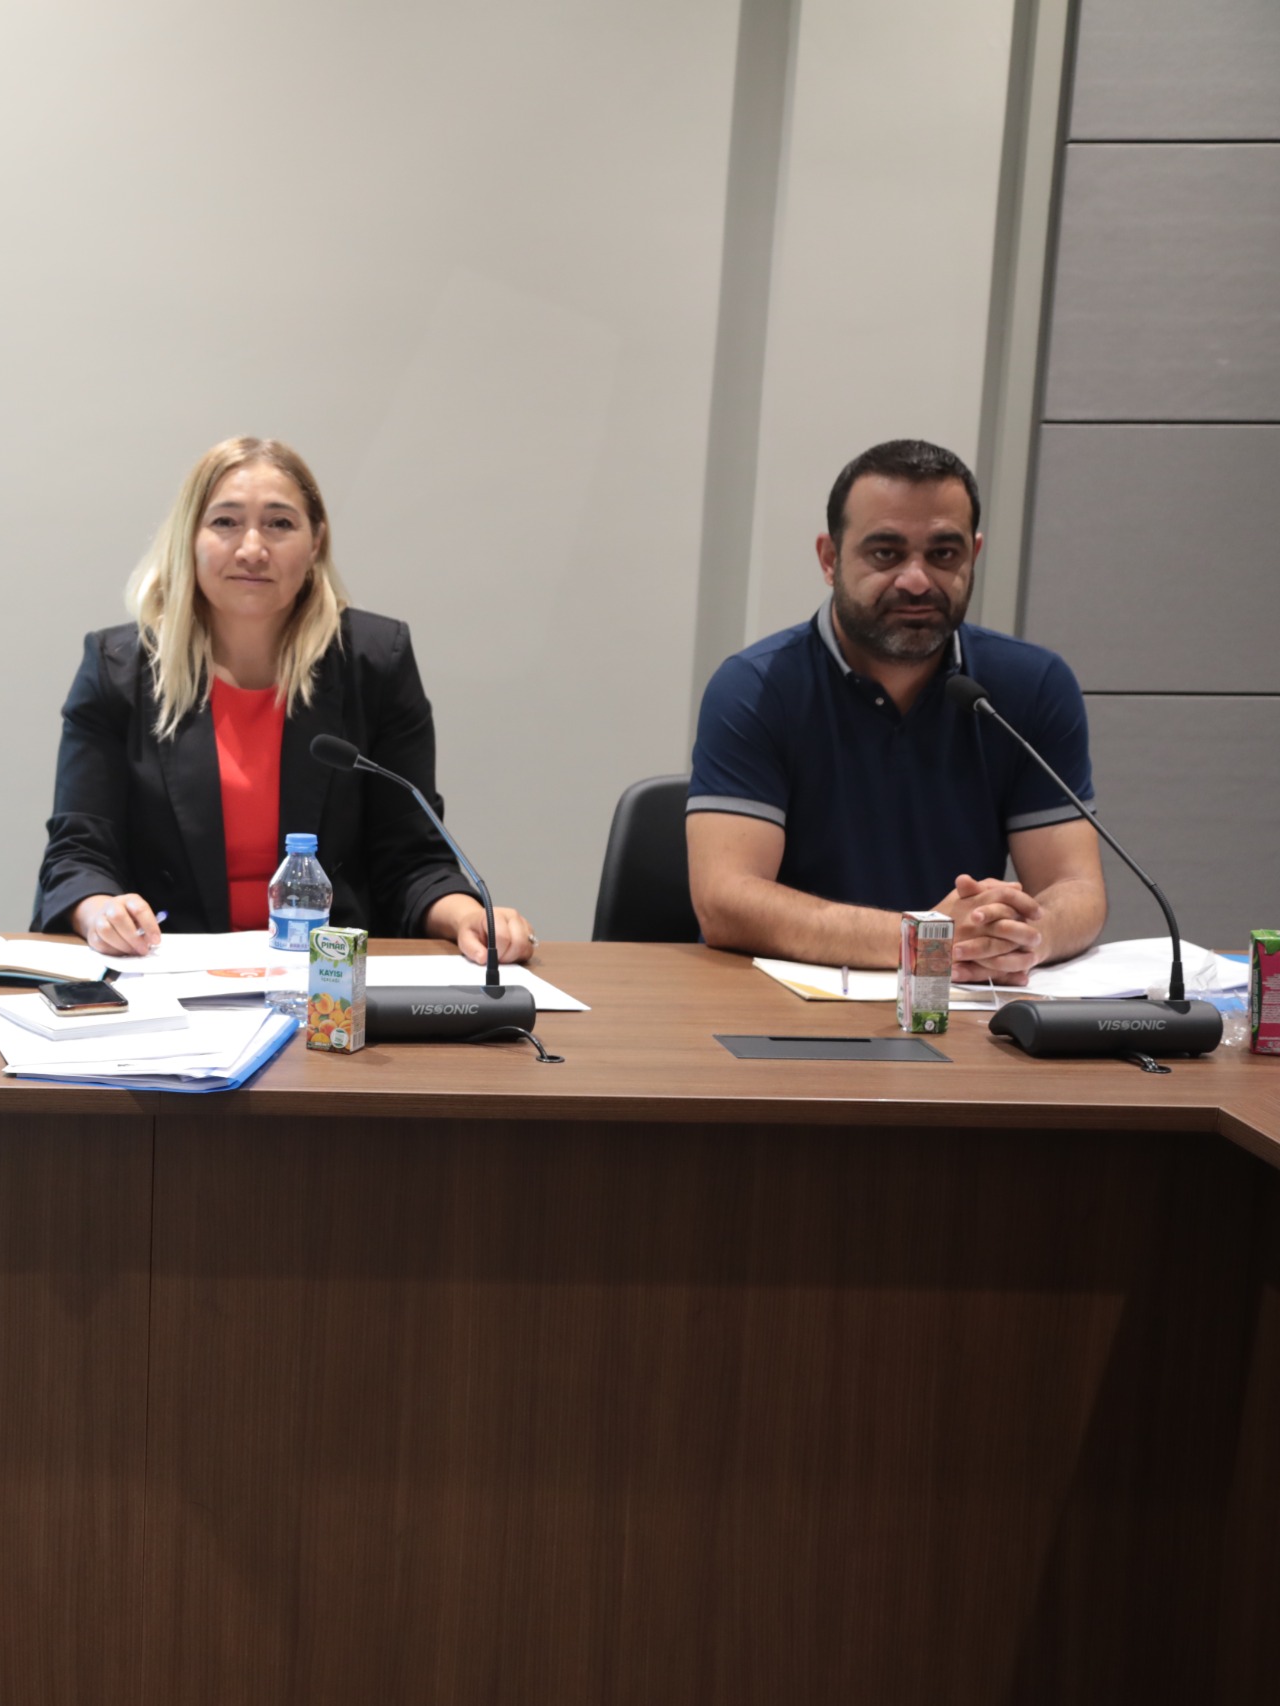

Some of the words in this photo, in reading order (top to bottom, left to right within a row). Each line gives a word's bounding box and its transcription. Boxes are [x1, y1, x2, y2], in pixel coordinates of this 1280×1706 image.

[321, 941, 346, 951] PINAR
[319, 968, 343, 978] KAYISI
[410, 1004, 480, 1016] VISSONIC
[1097, 1020, 1167, 1031] VISSONIC
